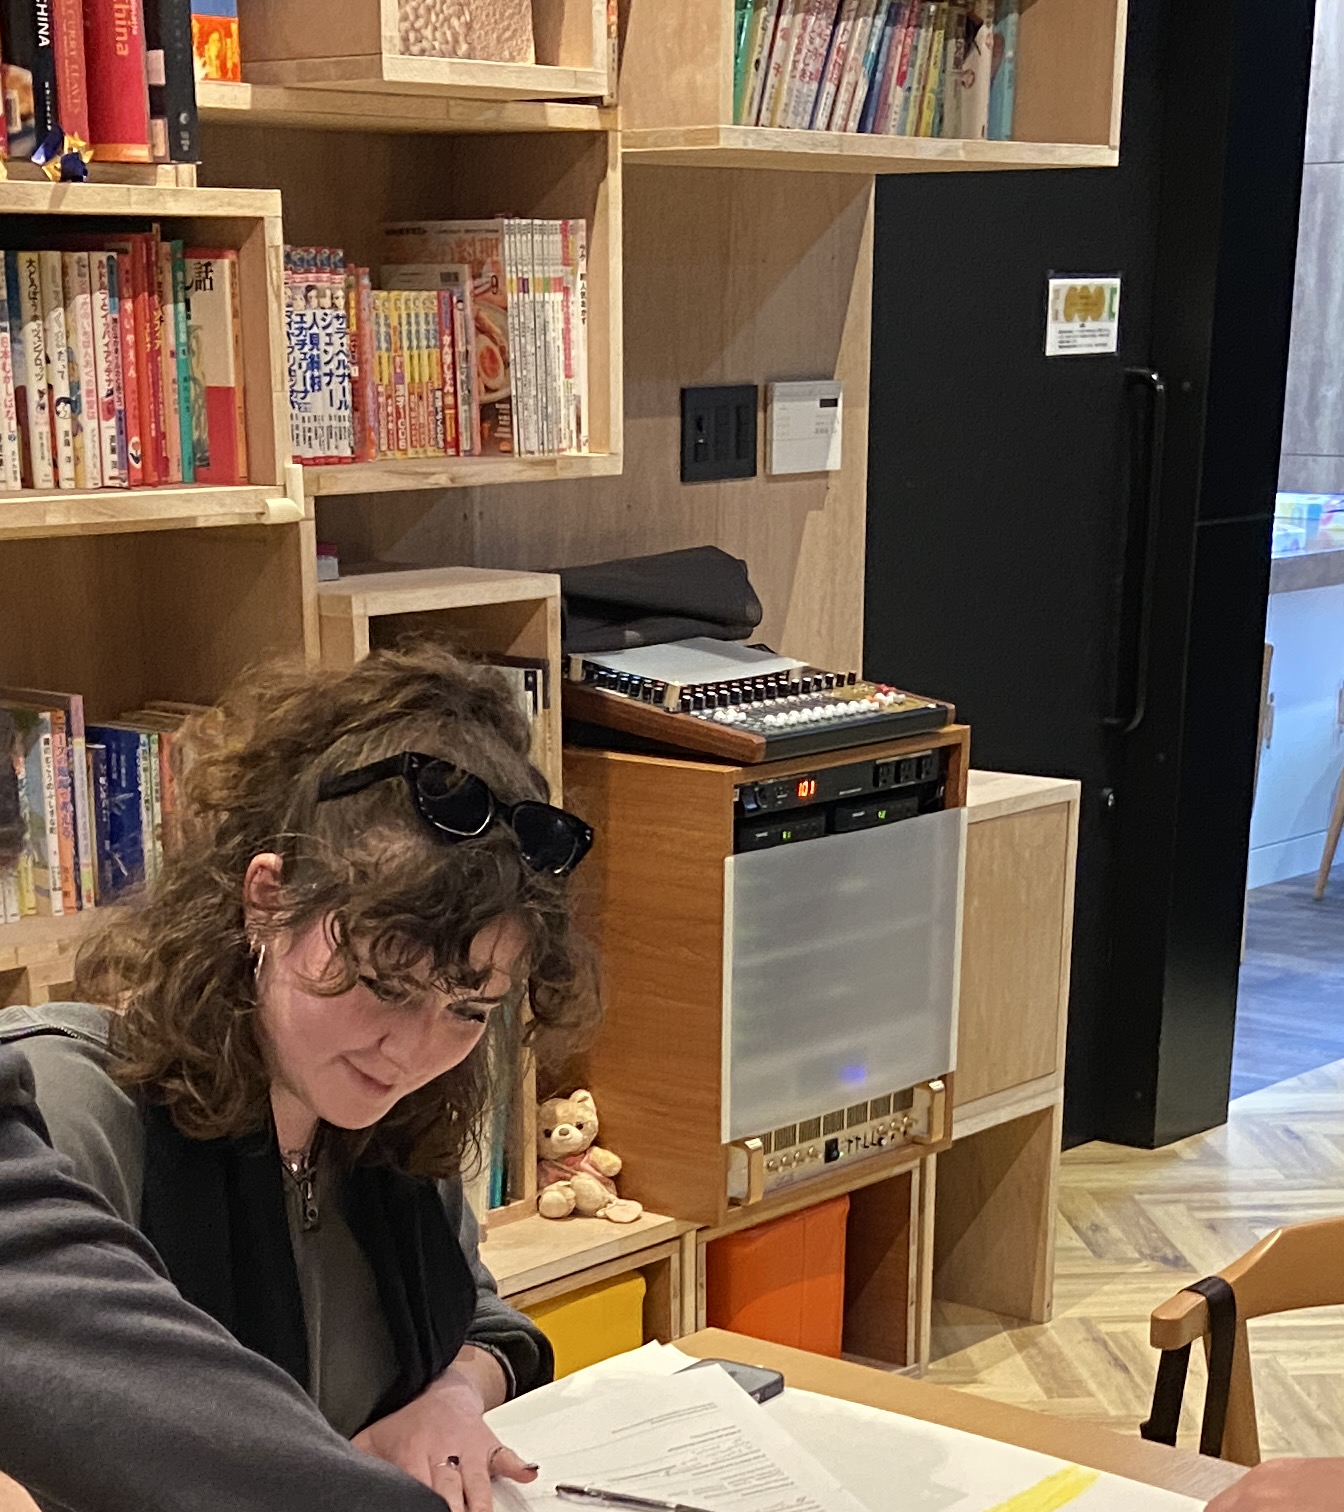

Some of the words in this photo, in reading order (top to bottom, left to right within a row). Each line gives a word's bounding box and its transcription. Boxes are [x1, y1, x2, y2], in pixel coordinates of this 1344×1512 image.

[36, 0, 50, 47] HINA
[112, 0, 129, 56] hina
[320, 311, 335, 408] ジェンナー
